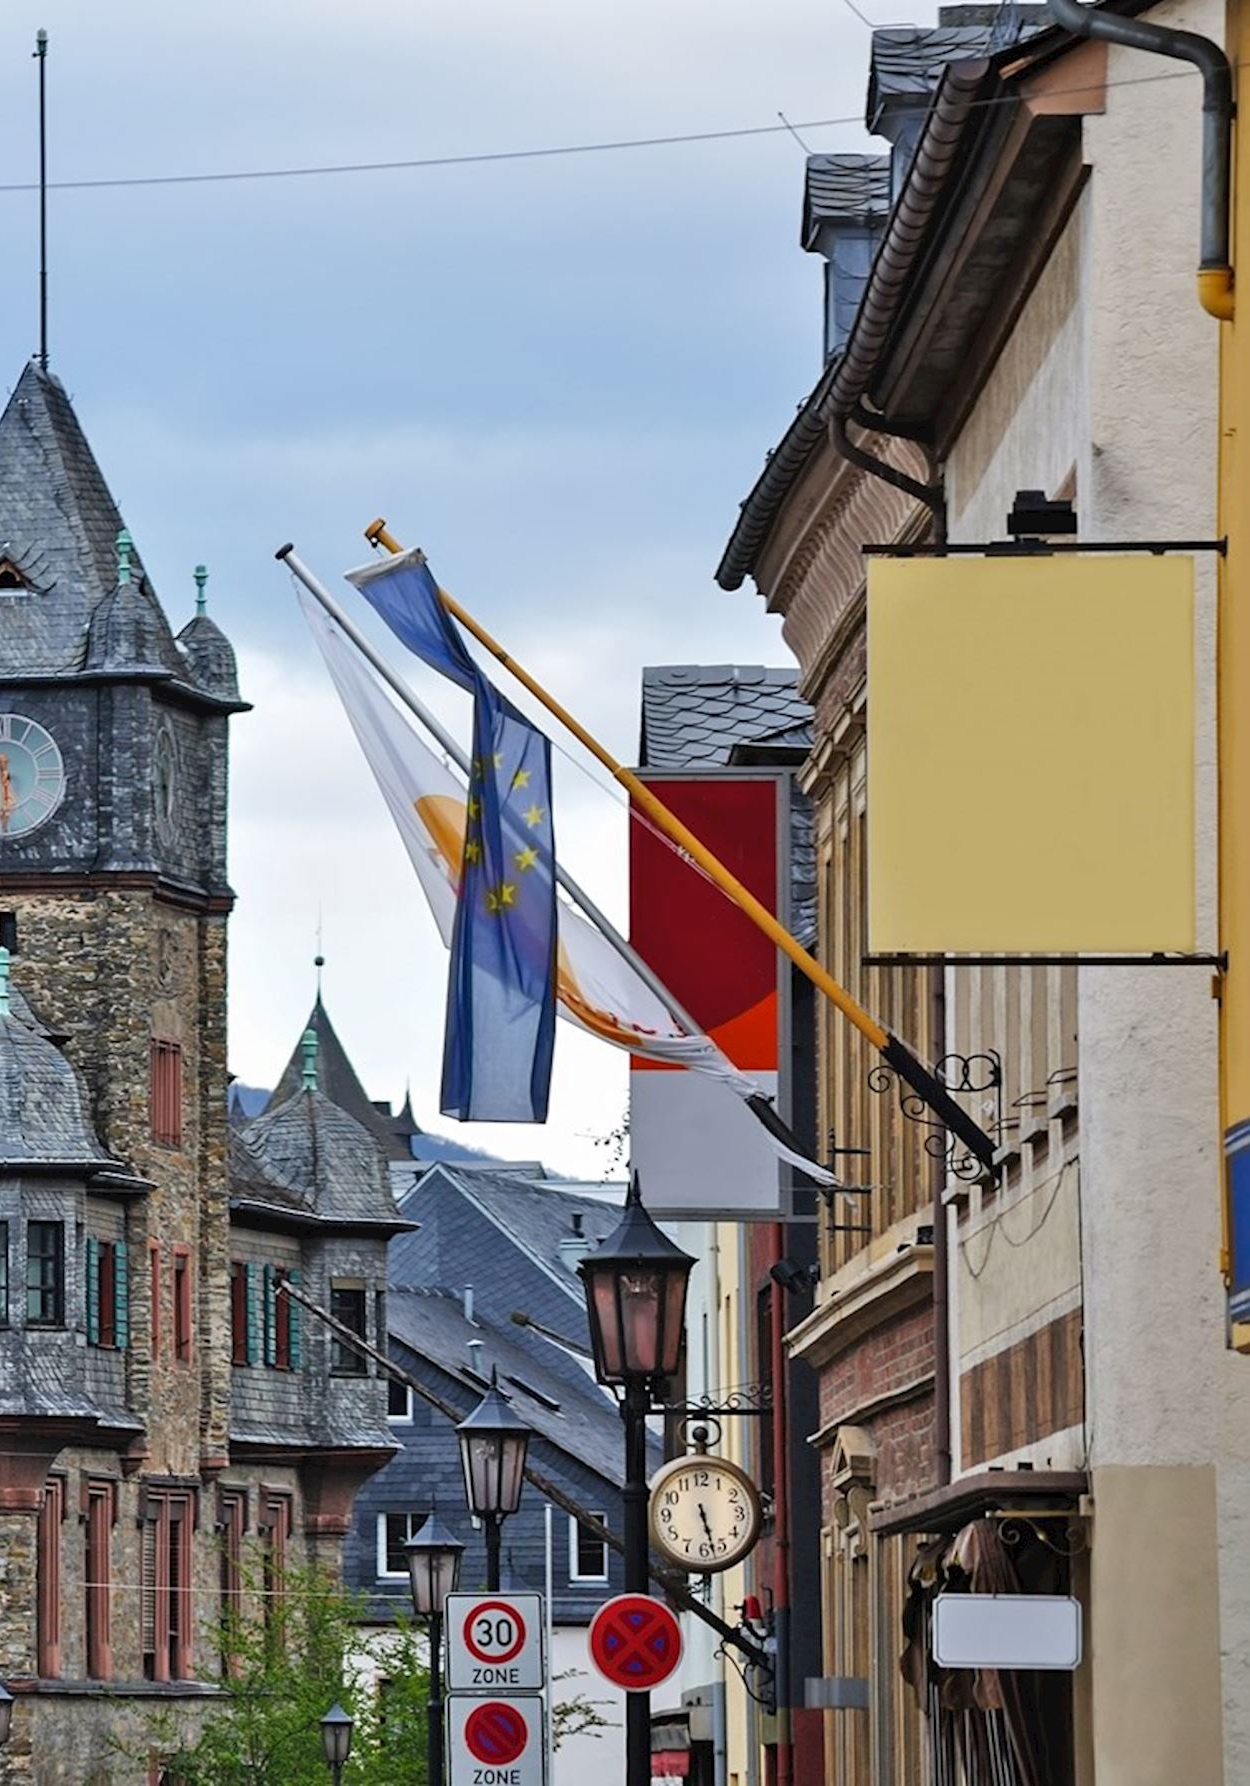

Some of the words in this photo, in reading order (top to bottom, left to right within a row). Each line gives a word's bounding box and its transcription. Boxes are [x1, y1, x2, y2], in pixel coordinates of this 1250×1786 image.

[678, 1478, 689, 1491] 11
[693, 1471, 709, 1487] 12
[716, 1478, 722, 1491] 1
[665, 1491, 679, 1505] 10
[728, 1488, 738, 1504] 2
[661, 1507, 672, 1523] 9
[734, 1505, 745, 1521] 3
[668, 1525, 679, 1541] 8
[728, 1525, 739, 1539] 4
[682, 1539, 692, 1553] 7
[699, 1543, 710, 1557] 6
[717, 1537, 727, 1552] 5
[476, 1618, 513, 1647] 30
[472, 1668, 520, 1684] ZONE
[473, 1769, 521, 1785] ZONE
